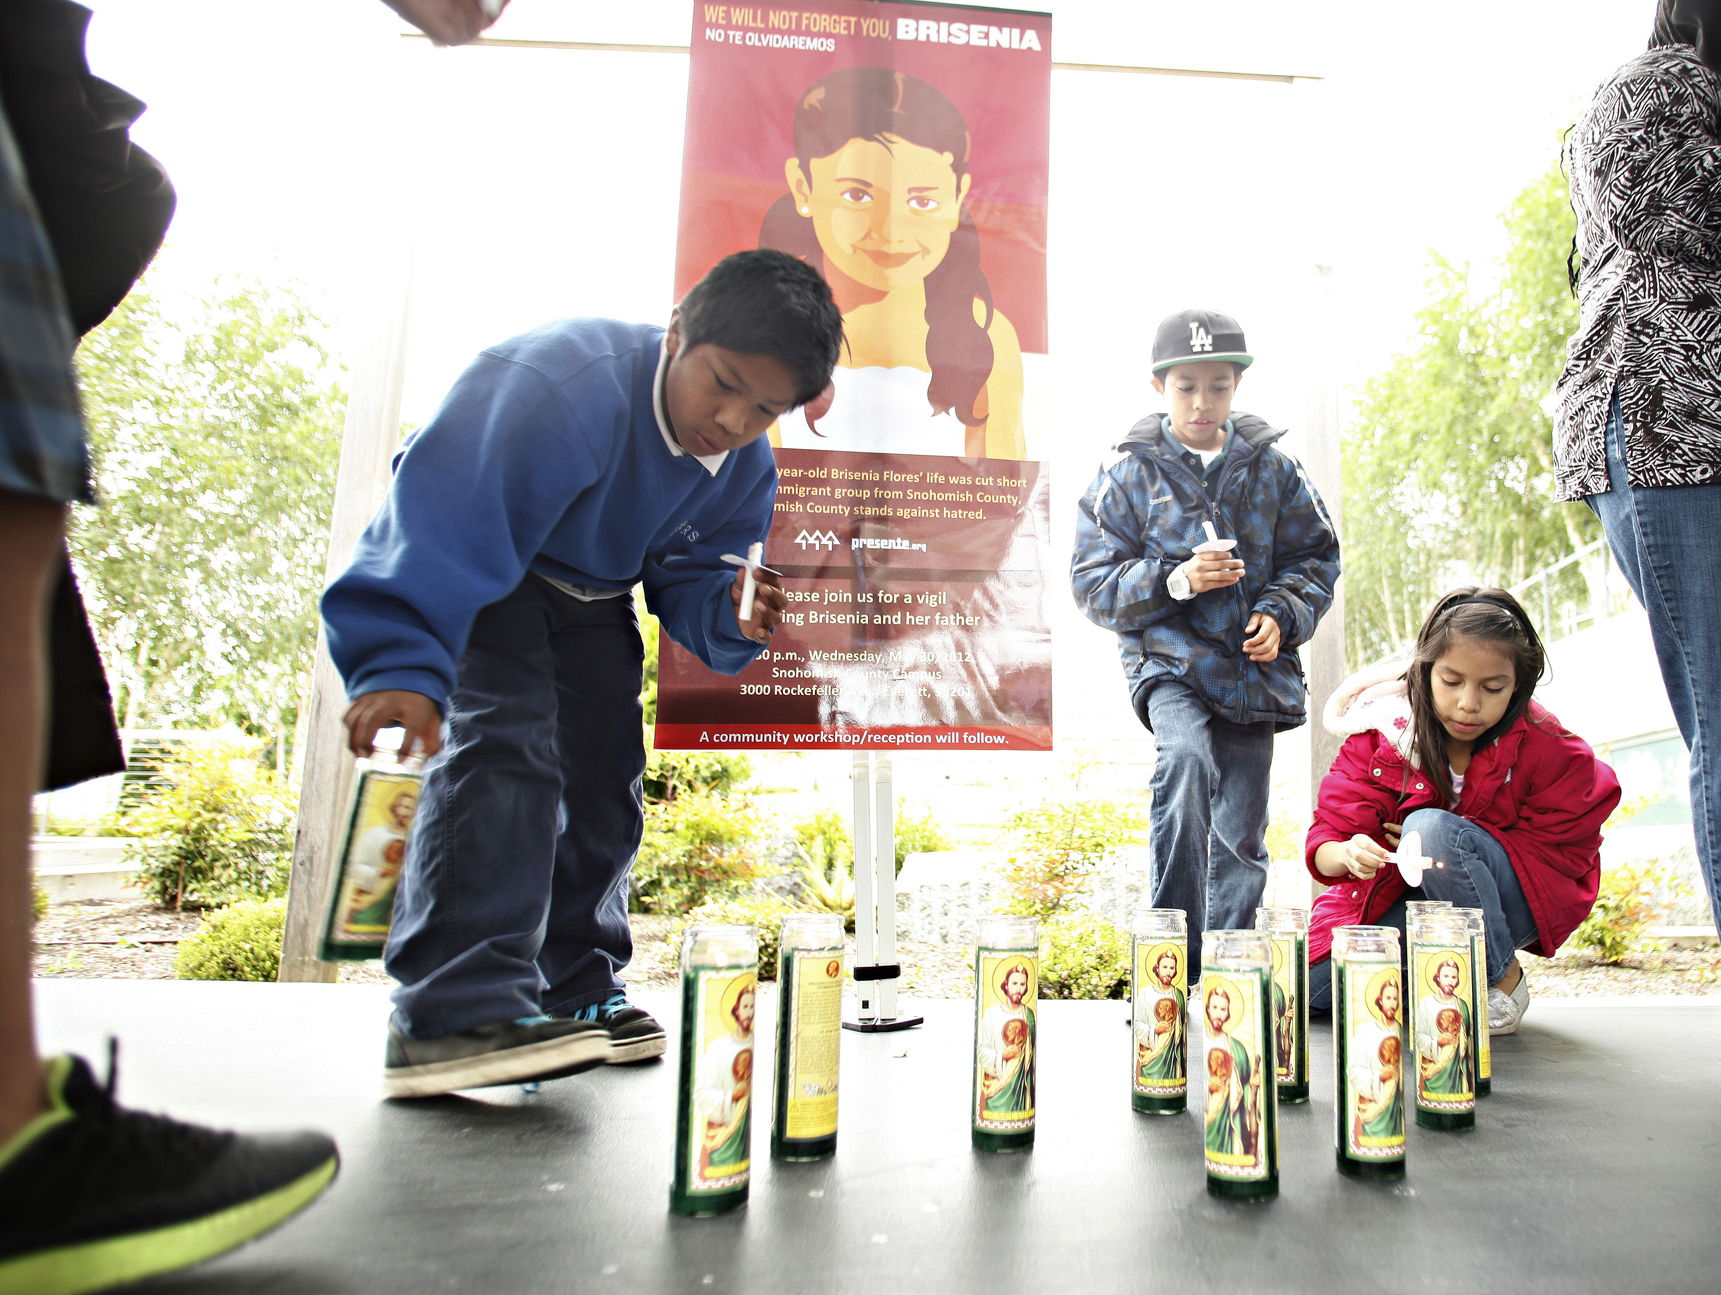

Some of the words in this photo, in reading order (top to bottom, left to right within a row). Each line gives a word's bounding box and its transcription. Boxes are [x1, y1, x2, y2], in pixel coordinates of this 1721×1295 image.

[704, 4, 727, 25] WE
[730, 7, 765, 28] WILL
[768, 10, 799, 30] NOT
[802, 12, 857, 35] FORGET
[860, 17, 893, 40] YOU,
[896, 17, 1042, 52] BRISENIA
[705, 27, 725, 43] NO
[727, 30, 743, 45] TE
[745, 31, 836, 53] OLVIDAREMOS
[1189, 321, 1213, 353] LA
[831, 468, 880, 481] Brisenia
[926, 472, 945, 484] life
[948, 475, 973, 485] was
[975, 476, 994, 487] cut
[996, 476, 1028, 488] short
[834, 487, 871, 500] group
[873, 487, 903, 499] from
[906, 489, 973, 503] Snohomish
[976, 492, 1022, 507] County.
[774, 500, 803, 513] mish
[806, 502, 851, 517] County
[853, 505, 894, 516] stands
[896, 506, 940, 519] against
[943, 507, 987, 520] hatred.
[823, 588, 852, 606] join
[857, 592, 874, 603] us
[878, 590, 900, 604] for
[904, 593, 912, 604] a
[917, 591, 947, 607] vigil
[808, 610, 869, 625] Brisenia
[873, 612, 902, 625] and
[906, 612, 931, 626] her
[934, 612, 981, 627] father
[773, 651, 805, 663] p.m.,
[808, 650, 886, 664] Wednesday,
[739, 684, 771, 696] 3000
[699, 731, 710, 743] A
[713, 731, 790, 745] community
[793, 731, 932, 746] workshop/reception
[935, 732, 959, 744] will
[963, 732, 1009, 745] follow.
